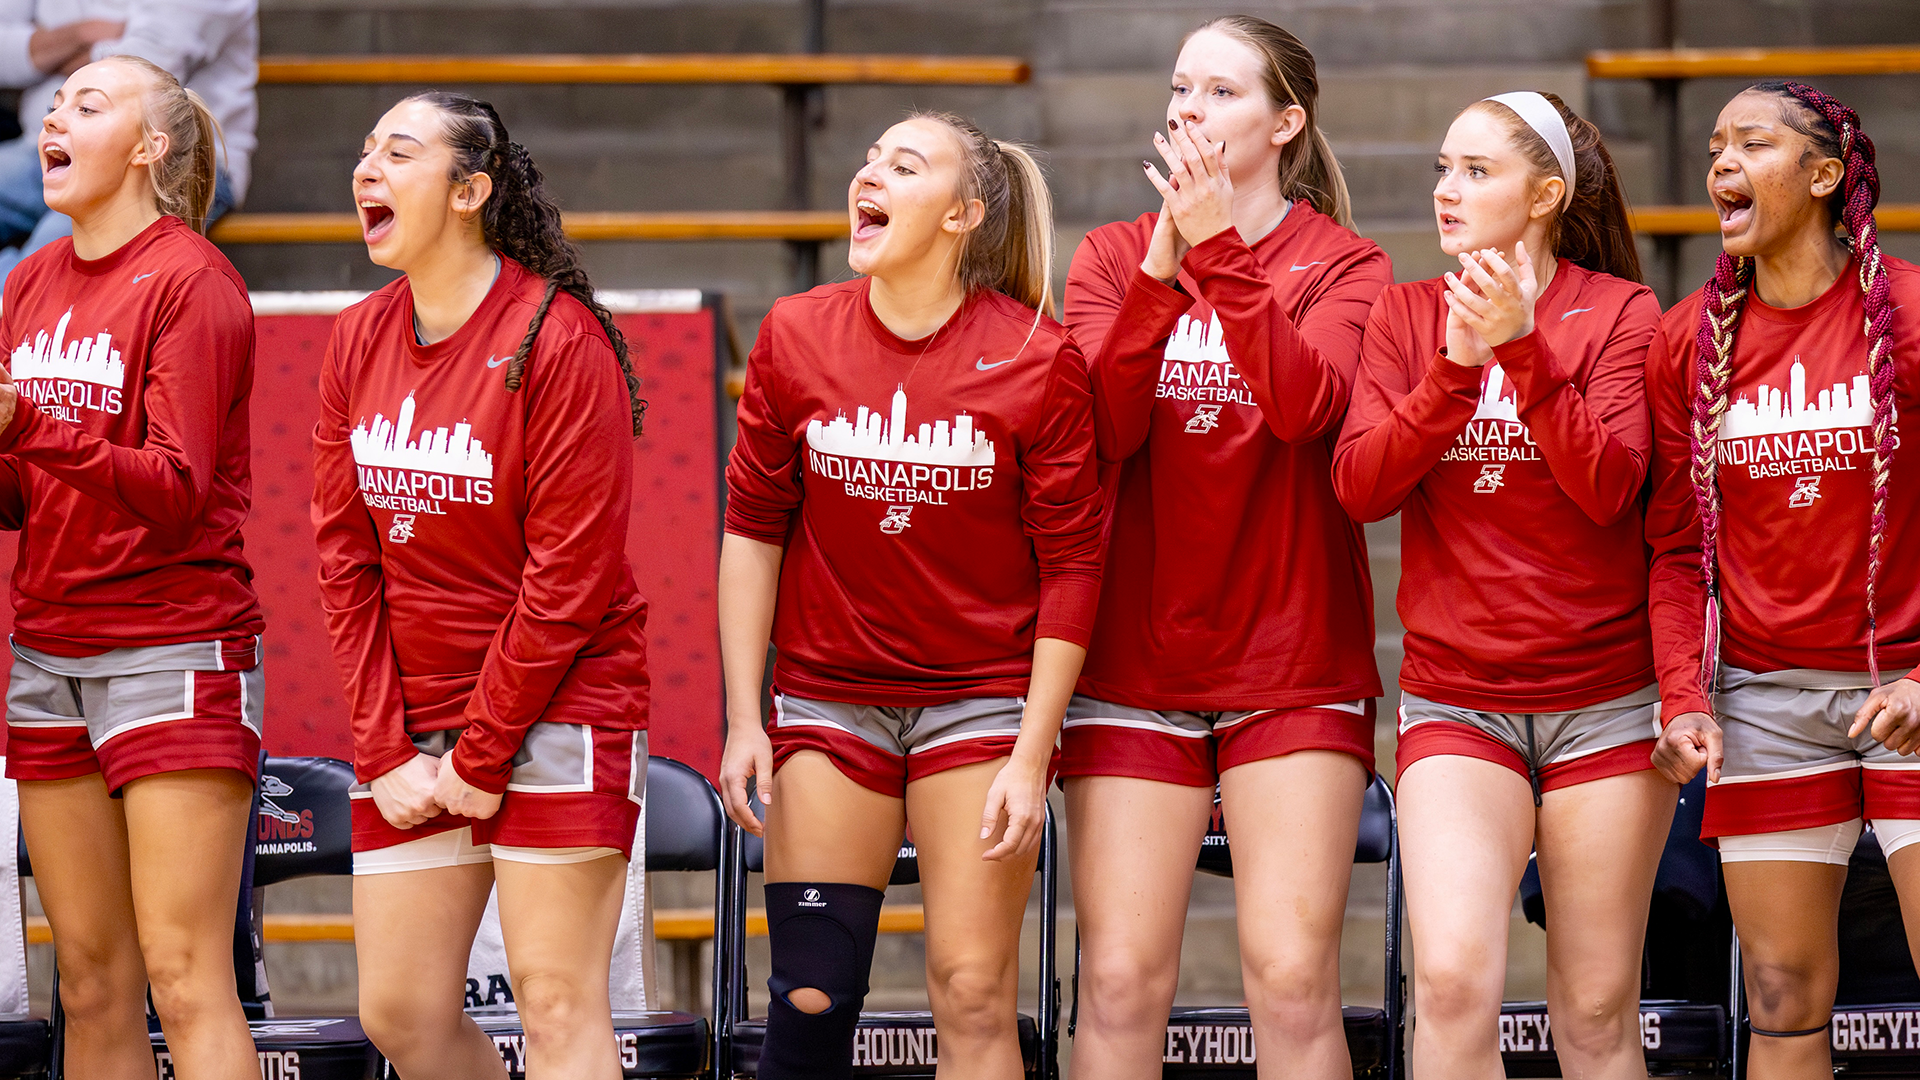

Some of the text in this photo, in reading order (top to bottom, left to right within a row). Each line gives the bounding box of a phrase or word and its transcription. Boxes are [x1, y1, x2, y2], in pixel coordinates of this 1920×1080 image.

[1155, 383, 1258, 406] BASKETBALL
[1717, 426, 1901, 466] INDIANAPOLS
[809, 449, 994, 492] INDIANAPOLIS
[1748, 456, 1857, 480] BASKETBALL
[362, 492, 447, 515] BASKETBALL
[844, 482, 949, 505] BASKETBALL
[1162, 1026, 1258, 1064] EYHOU
